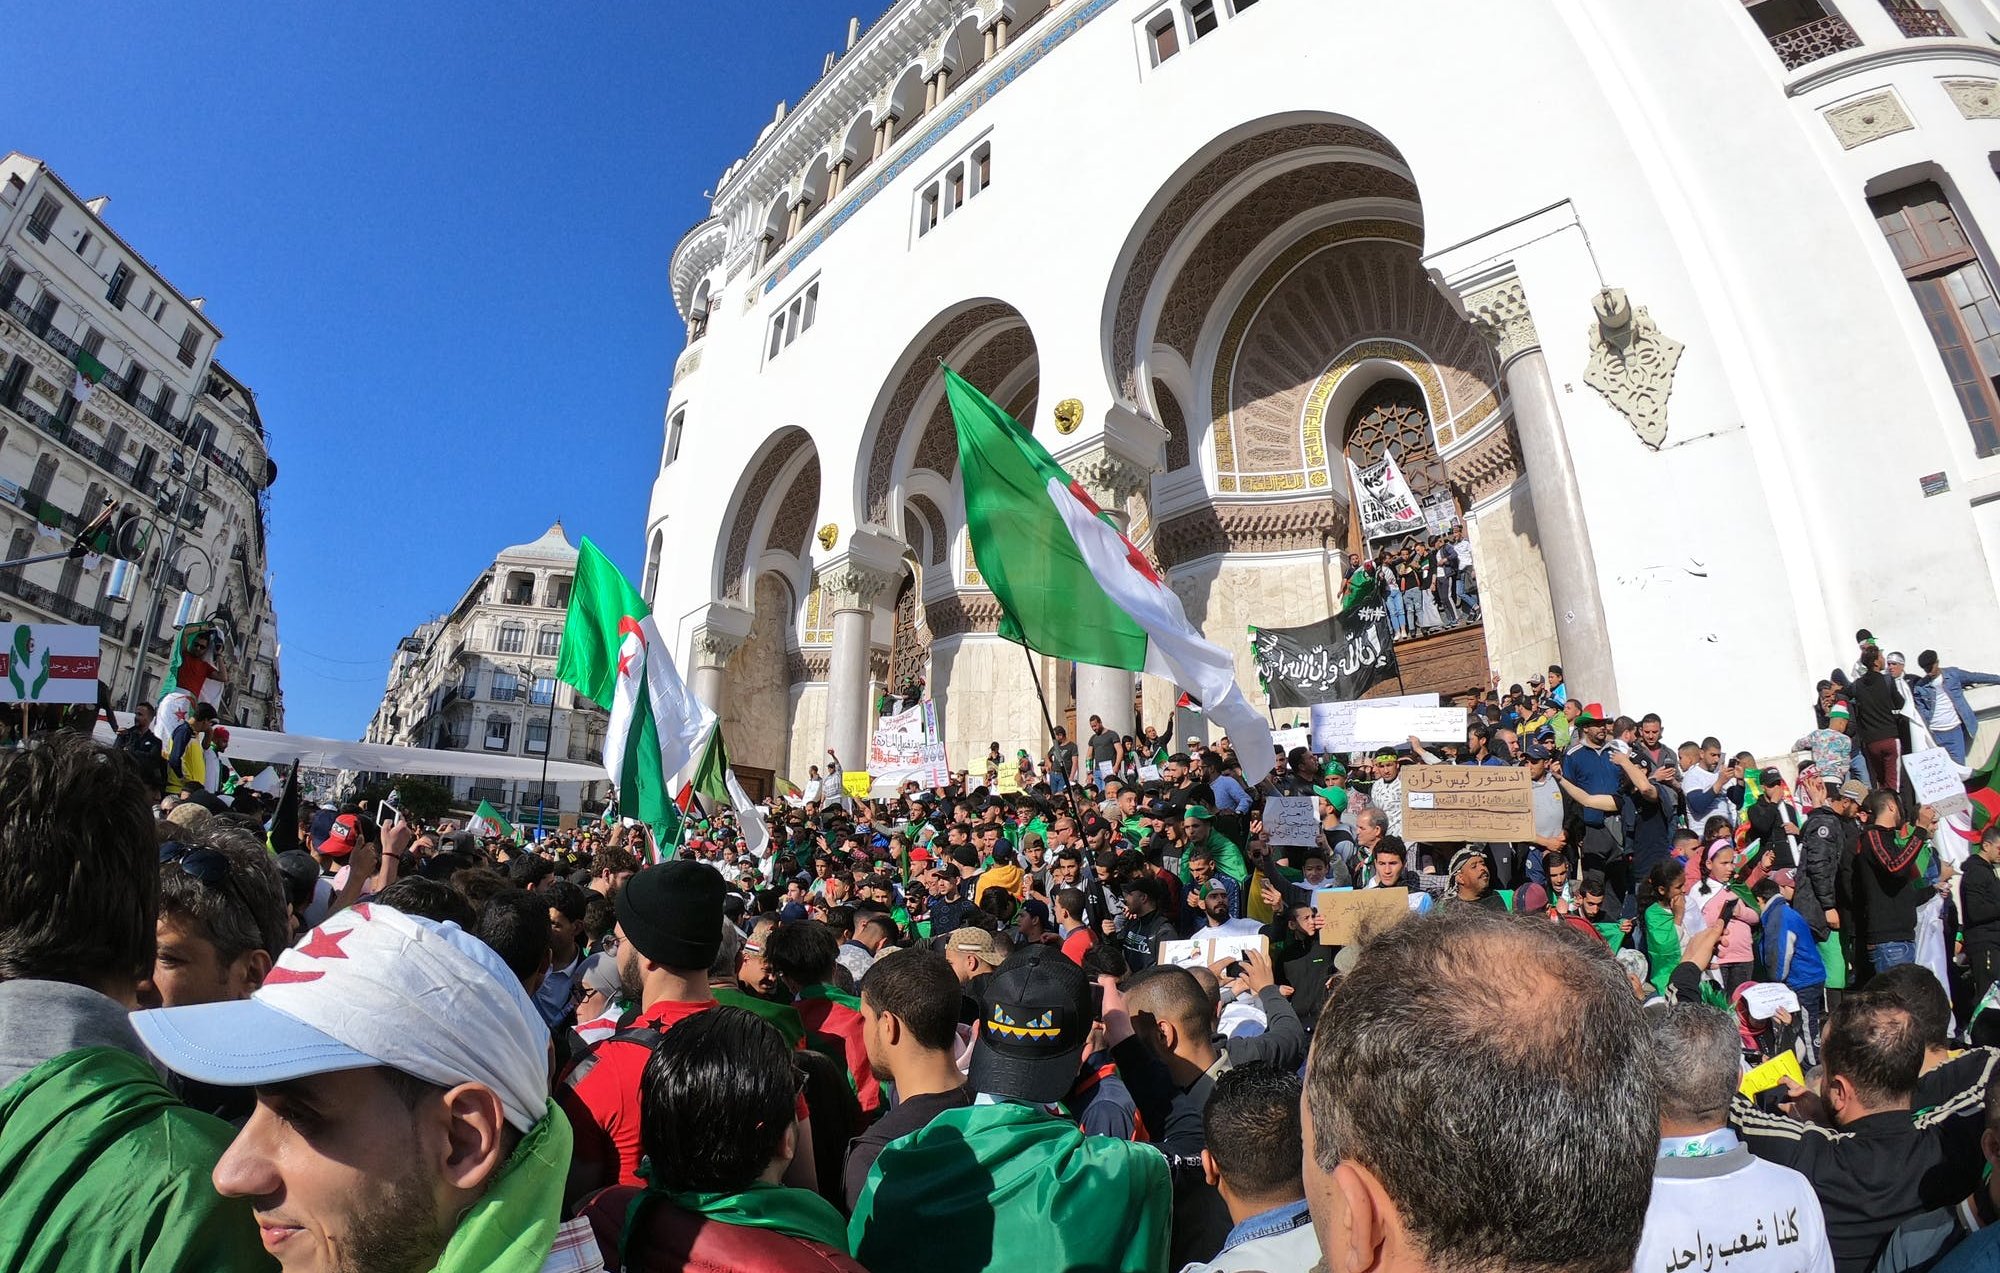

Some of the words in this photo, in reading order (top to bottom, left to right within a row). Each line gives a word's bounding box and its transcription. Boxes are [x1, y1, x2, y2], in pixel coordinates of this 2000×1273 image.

[1408, 767, 1442, 789] قرآن
[1446, 770, 1470, 789] ليس
[1475, 770, 1525, 788] الدستور
[1773, 1206, 1799, 1246] كلنا
[1666, 1229, 1713, 1273] واحد
[1719, 1218, 1767, 1267] شعب
